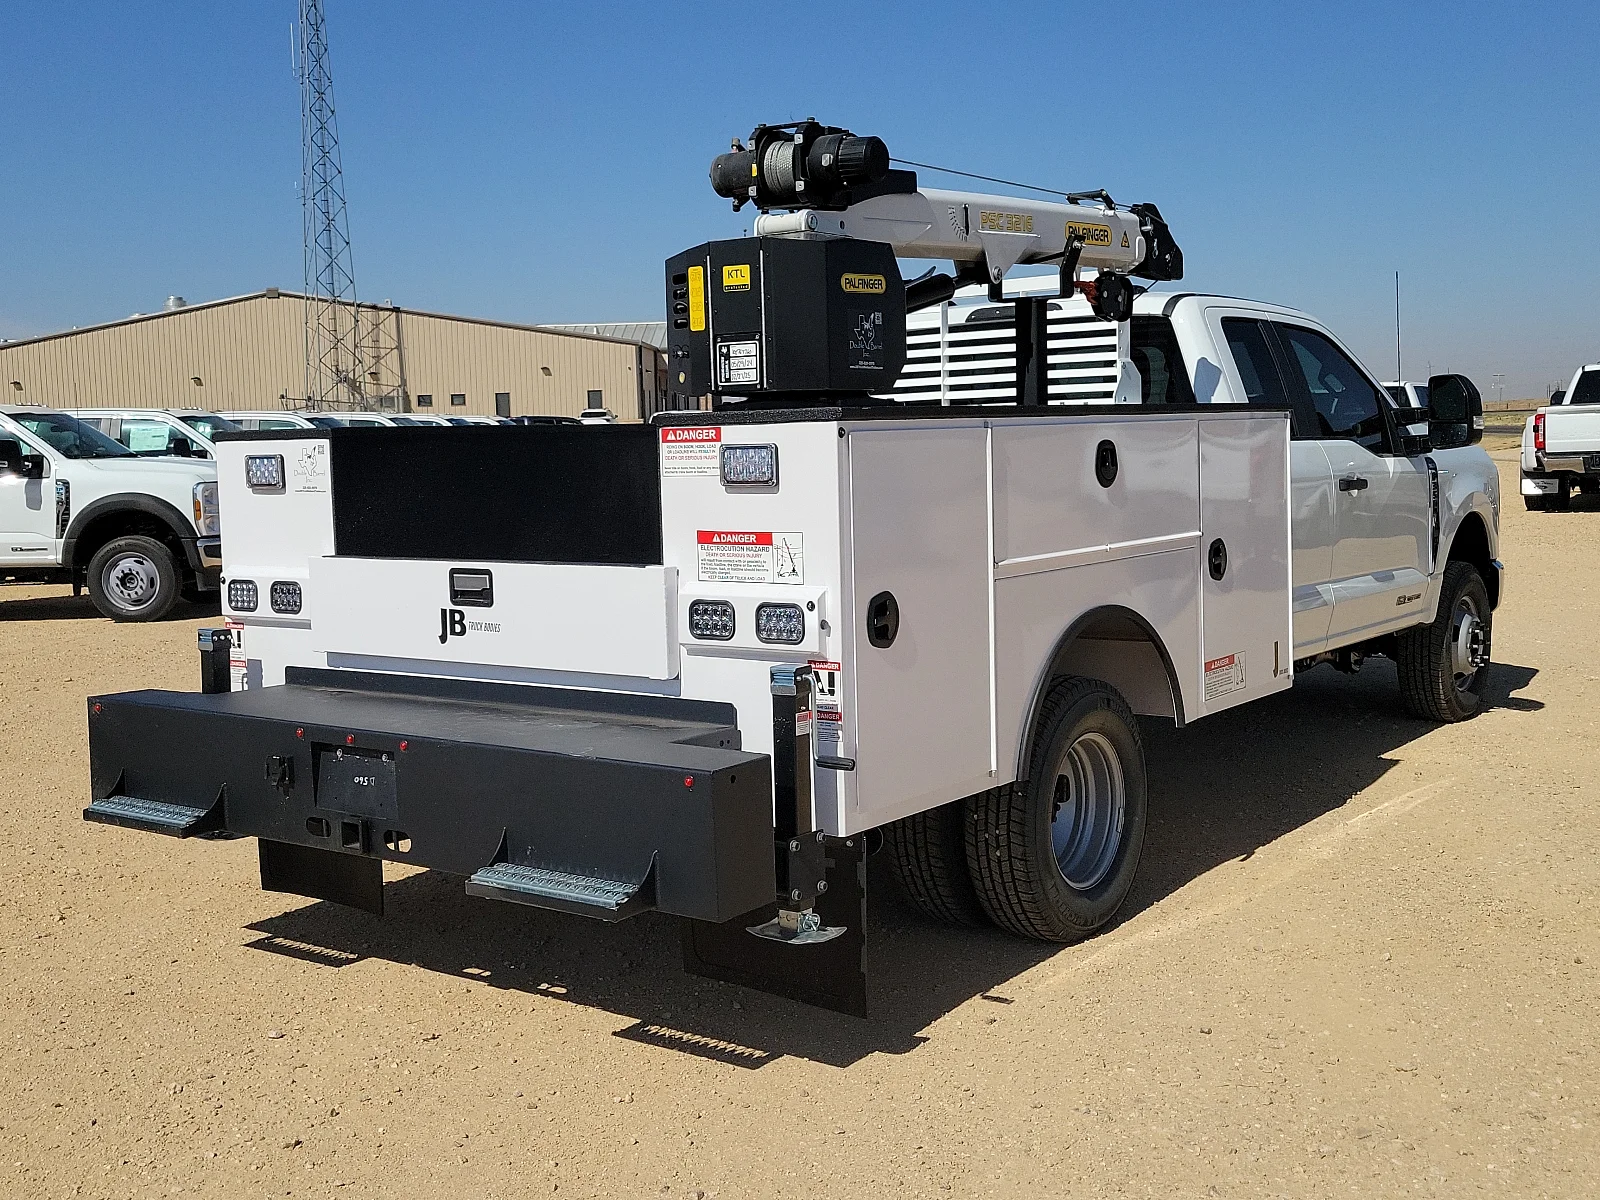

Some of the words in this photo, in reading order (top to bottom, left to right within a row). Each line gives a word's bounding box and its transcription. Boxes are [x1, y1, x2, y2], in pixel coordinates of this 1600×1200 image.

[980, 211, 1004, 230] PSC
[1006, 214, 1033, 232] 3216
[728, 268, 746, 280] KTL
[844, 278, 883, 290] PALFINGER
[676, 430, 716, 440] DANGER
[720, 534, 756, 543] DANGER
[438, 608, 466, 644] JB
